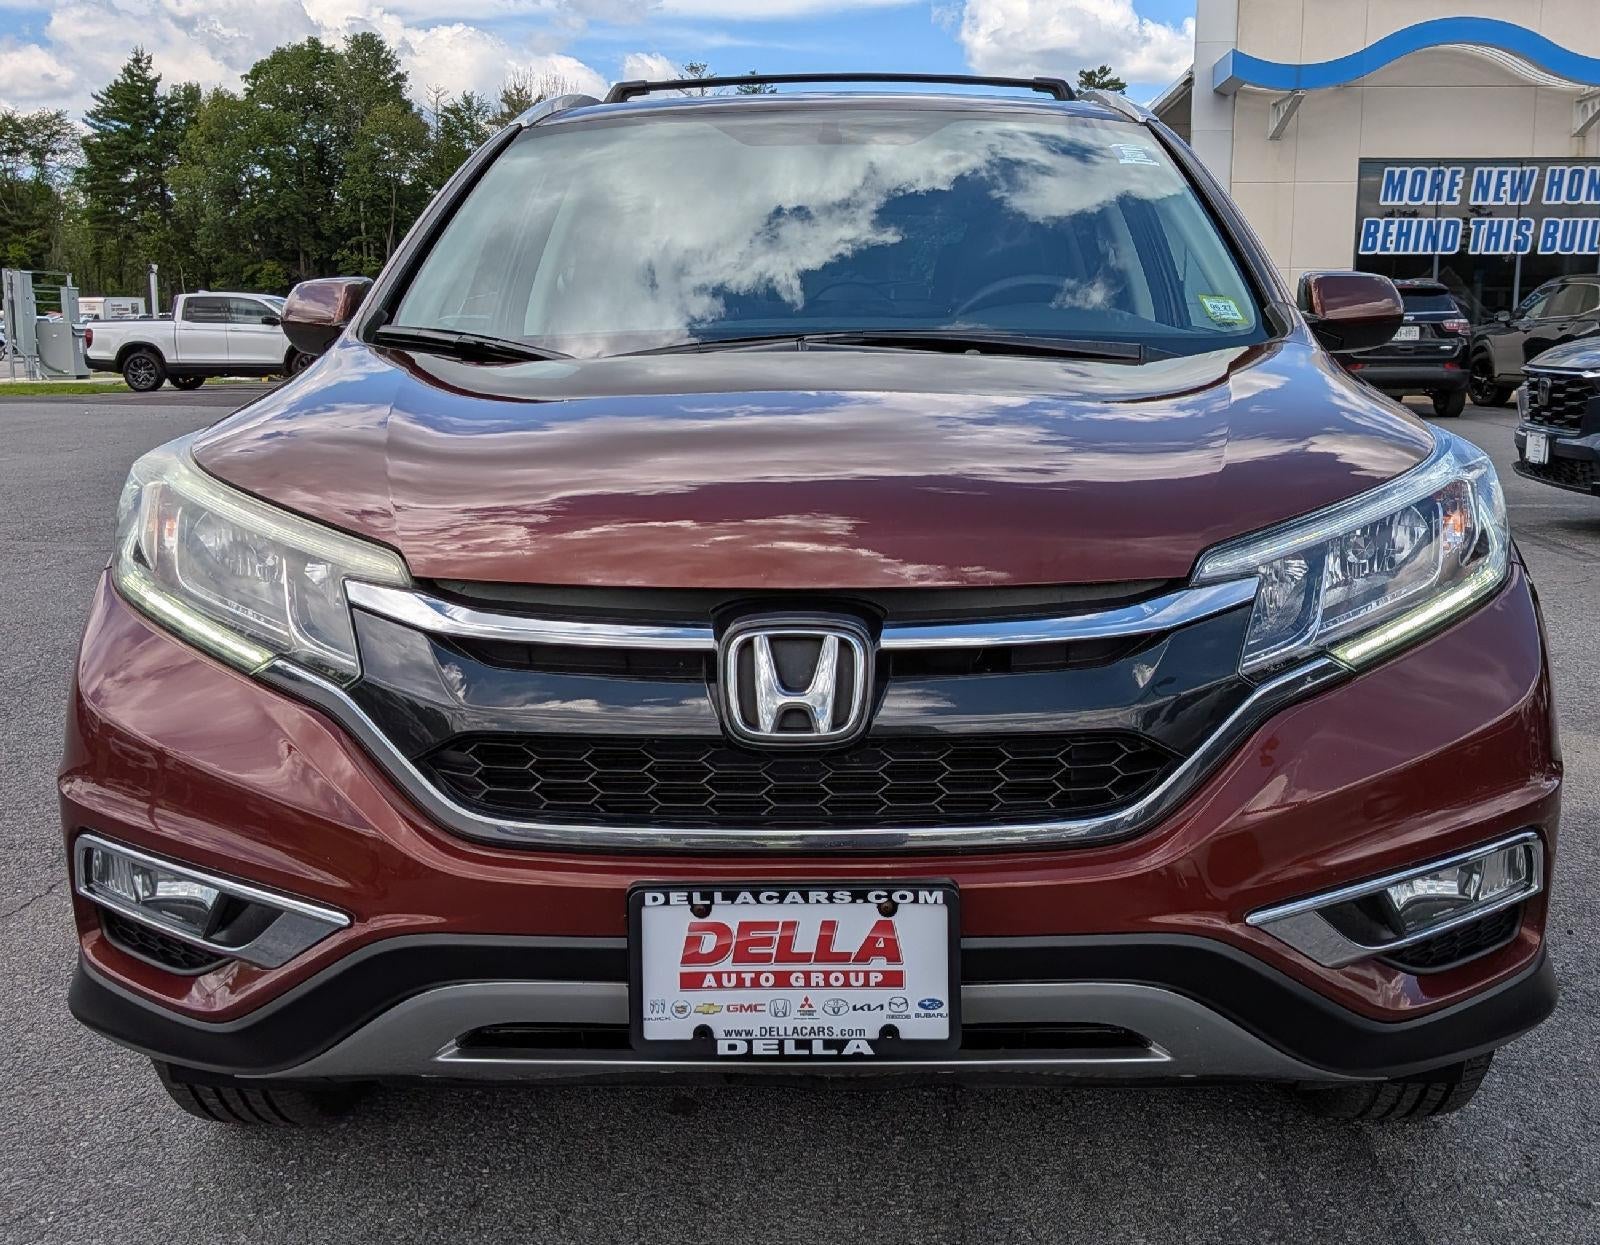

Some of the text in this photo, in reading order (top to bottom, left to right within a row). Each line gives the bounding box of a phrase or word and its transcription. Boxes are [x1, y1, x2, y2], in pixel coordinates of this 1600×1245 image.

[1379, 167, 1465, 205] MORE
[1469, 166, 1539, 205] NEW
[1358, 218, 1600, 255] BEHIND THIS BUIL
[644, 890, 945, 906] DELLACARS.COM
[680, 919, 904, 966] DELLA
[701, 972, 884, 988] AUTO GROUP
[726, 1003, 766, 1013] GMC
[723, 1025, 866, 1038] www.DELLACARS.com
[717, 1039, 875, 1055] DELLA
